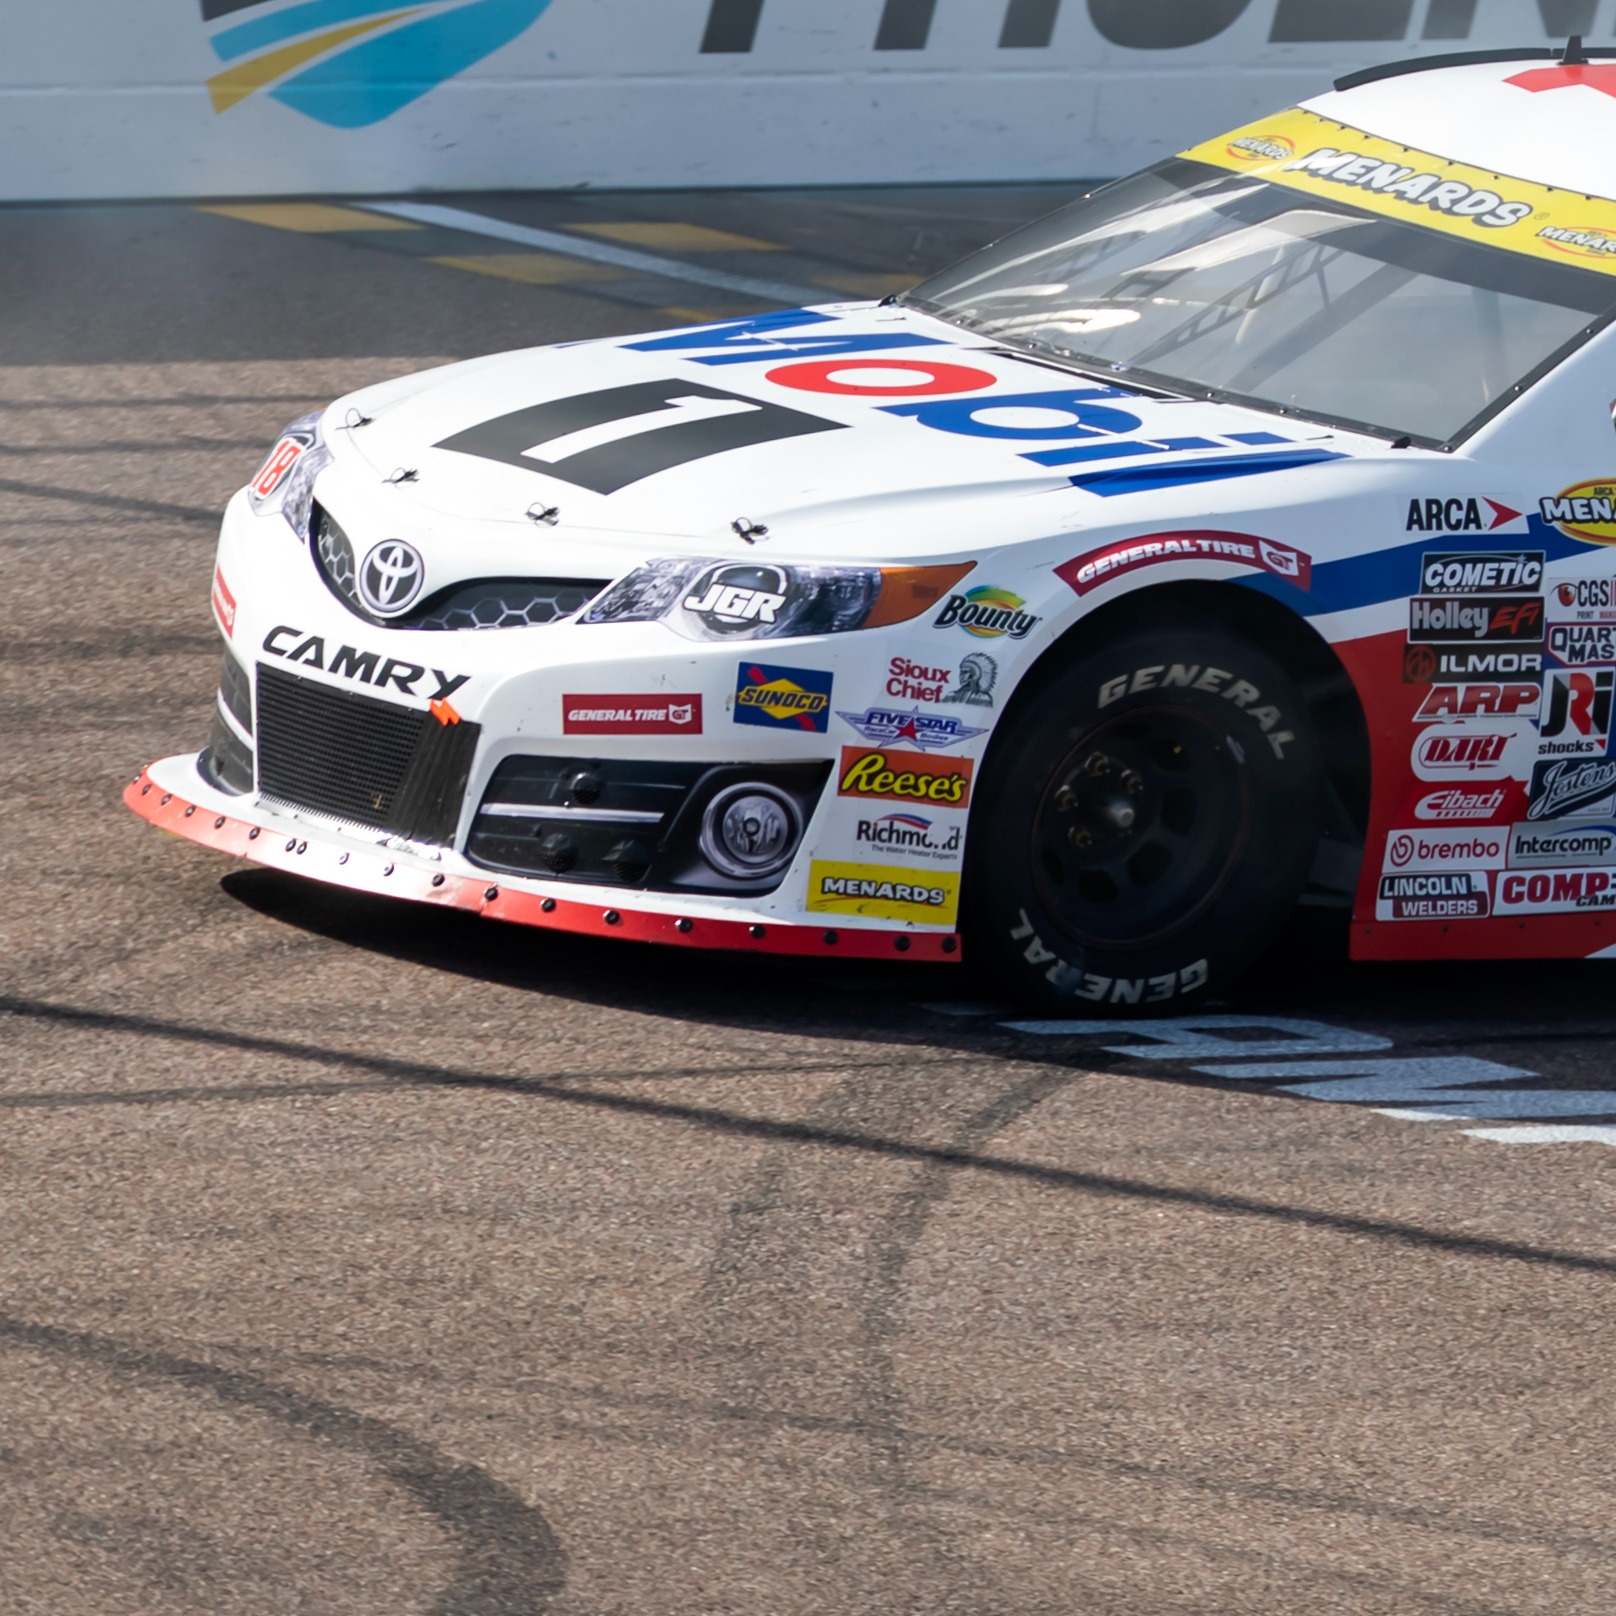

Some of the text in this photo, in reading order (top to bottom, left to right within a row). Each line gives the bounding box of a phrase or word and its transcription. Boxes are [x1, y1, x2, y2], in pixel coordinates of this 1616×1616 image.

[1229, 137, 1293, 160] MENARDS
[1286, 147, 1534, 228] MENARDS
[617, 309, 1353, 497] Mobil
[250, 440, 302, 496] 18
[1406, 497, 1482, 531] ARCA
[1076, 540, 1198, 583] GENERAL
[1199, 540, 1256, 559] TIRE
[684, 584, 786, 624] JGR
[933, 593, 1037, 639] Bounty
[1576, 611, 1594, 619] PRINT
[1412, 601, 1490, 637] Holley
[261, 625, 473, 702] CAMRY
[889, 657, 951, 683] Sioux
[1440, 654, 1541, 673] ILMOR
[740, 687, 827, 712] SUNOCO
[886, 678, 943, 703] Chief
[1418, 684, 1540, 715] ARP
[567, 708, 635, 722] GENERAL
[636, 709, 667, 722] TIRE
[865, 711, 958, 733] FIVE STAR
[1097, 664, 1295, 759] GENERAL
[1538, 739, 1595, 755] shocks
[841, 753, 967, 802] Reese's
[1415, 789, 1505, 814] Eibach
[856, 819, 961, 851] Richmod
[1515, 835, 1613, 856] Intercomp
[871, 844, 957, 861] The Water Heater Experts
[1418, 838, 1499, 860] brembo
[822, 877, 945, 904] MENARDS
[1384, 876, 1467, 897] LINCOLN
[1502, 872, 1610, 904] COMP
[1401, 899, 1478, 916] WELDERS
